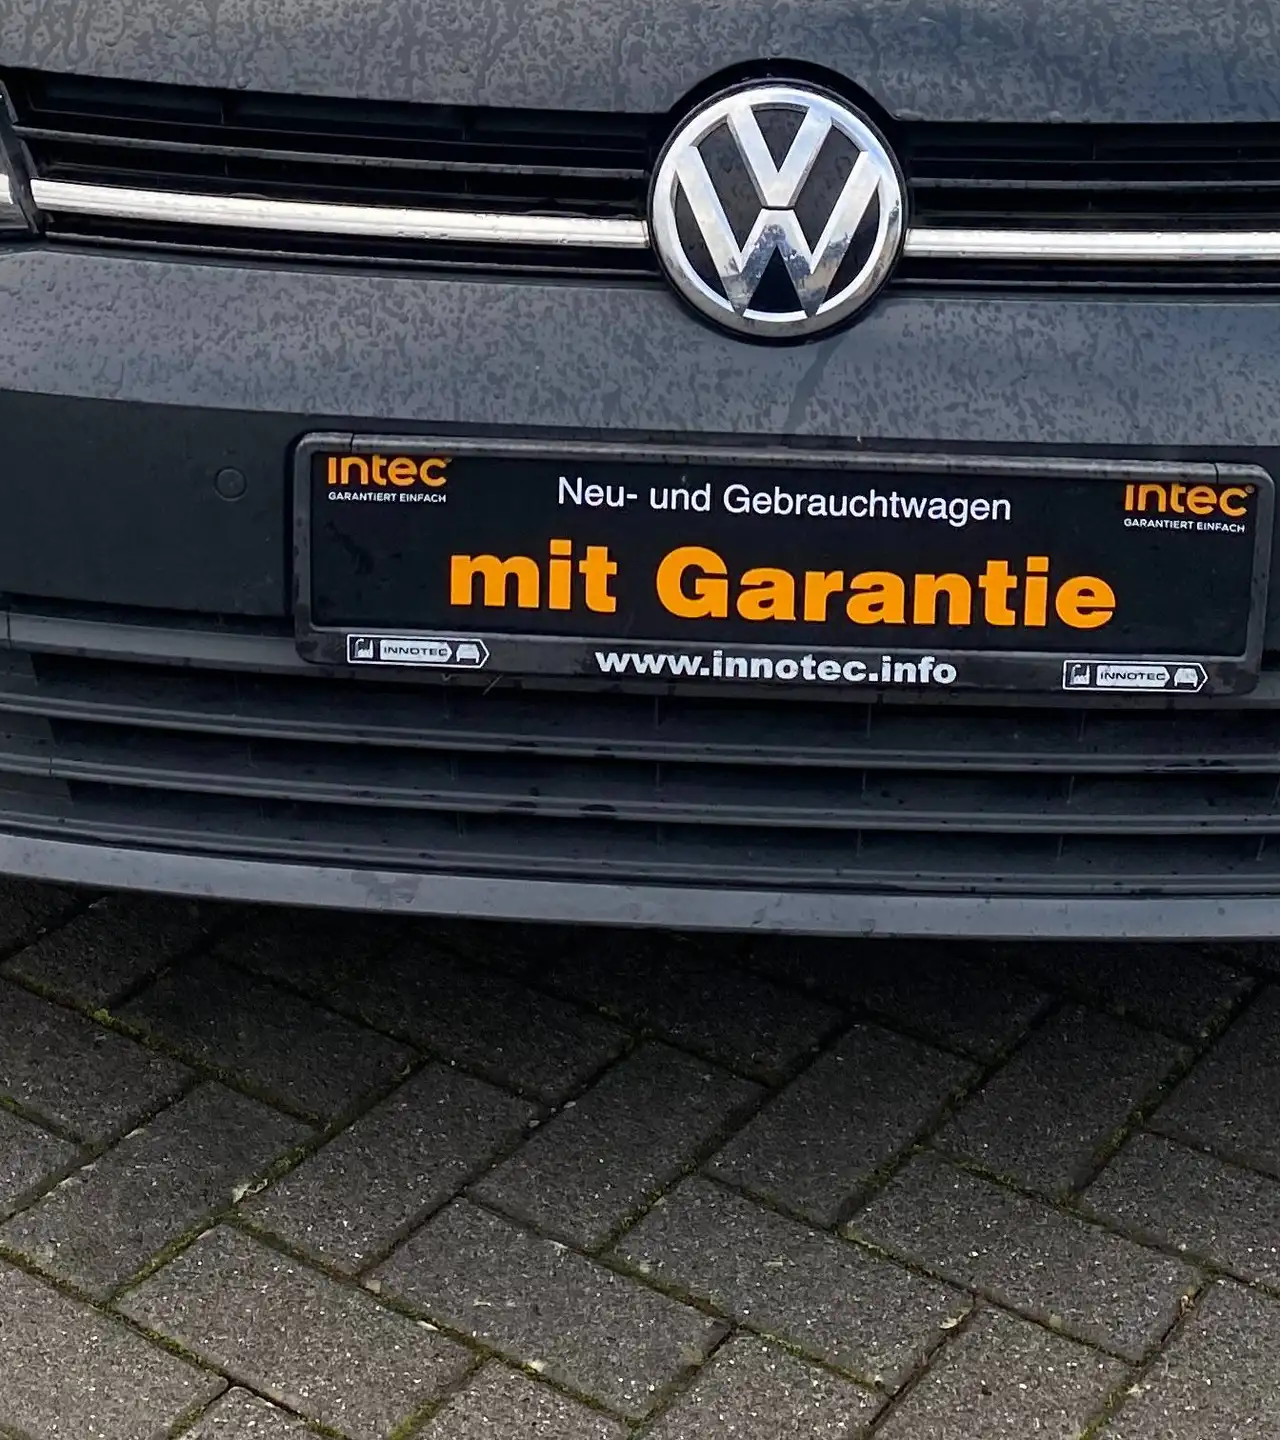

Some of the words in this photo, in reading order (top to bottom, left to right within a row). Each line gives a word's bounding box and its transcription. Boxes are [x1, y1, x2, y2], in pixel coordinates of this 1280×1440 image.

[328, 455, 447, 487] intec
[328, 491, 397, 502] GARANTIERT
[400, 493, 447, 503] EINFACH
[558, 476, 638, 507] Neu-
[650, 483, 711, 512] und
[723, 484, 1011, 527] Gebrauchtwagen
[1124, 484, 1248, 517] intec
[1123, 518, 1194, 530] GARANTIERT
[1196, 521, 1246, 533] EINFACH
[450, 539, 617, 613] mit
[655, 545, 1117, 629] Garantie
[383, 646, 448, 657] INNOTEC
[595, 649, 957, 685] www.innotec.info
[1100, 672, 1166, 681] INNOTEC
